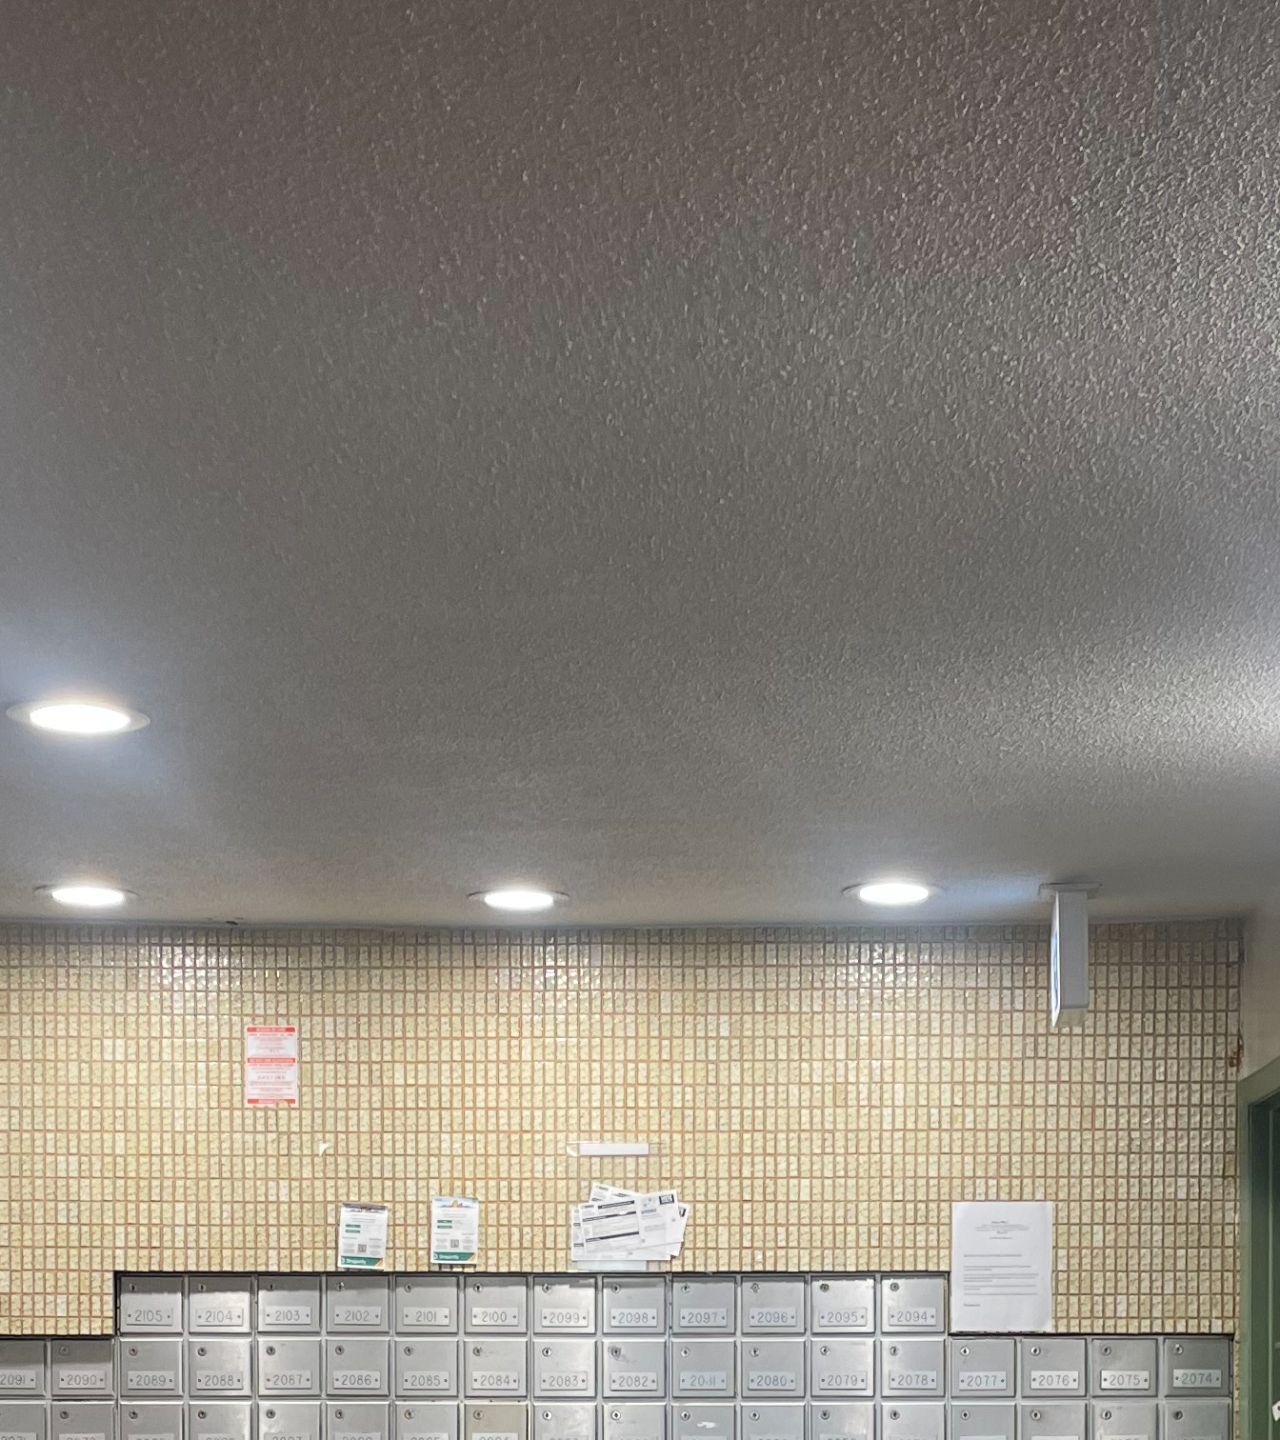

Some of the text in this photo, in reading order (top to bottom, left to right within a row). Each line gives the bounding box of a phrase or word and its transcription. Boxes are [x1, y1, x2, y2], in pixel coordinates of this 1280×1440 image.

[134, 1309, 163, 1323] 2105
[204, 1309, 233, 1324] 2104
[274, 1309, 301, 1322] 2103
[344, 1309, 371, 1322] 2102
[415, 1310, 437, 1323] 2101
[481, 1310, 508, 1323] 2100
[549, 1311, 580, 1324] 2099
[618, 1311, 649, 1325] 2098
[757, 1311, 789, 1324] 2096
[826, 1311, 858, 1324] 2095
[896, 1310, 928, 1323] 2094
[341, 1374, 372, 1386] 2086
[479, 1374, 510, 1387] 2084
[548, 1375, 579, 1388] 2083
[618, 1375, 649, 1388] 2082
[756, 1374, 788, 1387] 2080
[827, 1374, 858, 1387] 2079
[897, 1373, 930, 1386] 2078
[966, 1374, 998, 1388] 2077
[1038, 1374, 1070, 1387] 2076
[1109, 1374, 1141, 1387] 2075
[1181, 1372, 1212, 1385] 2074
